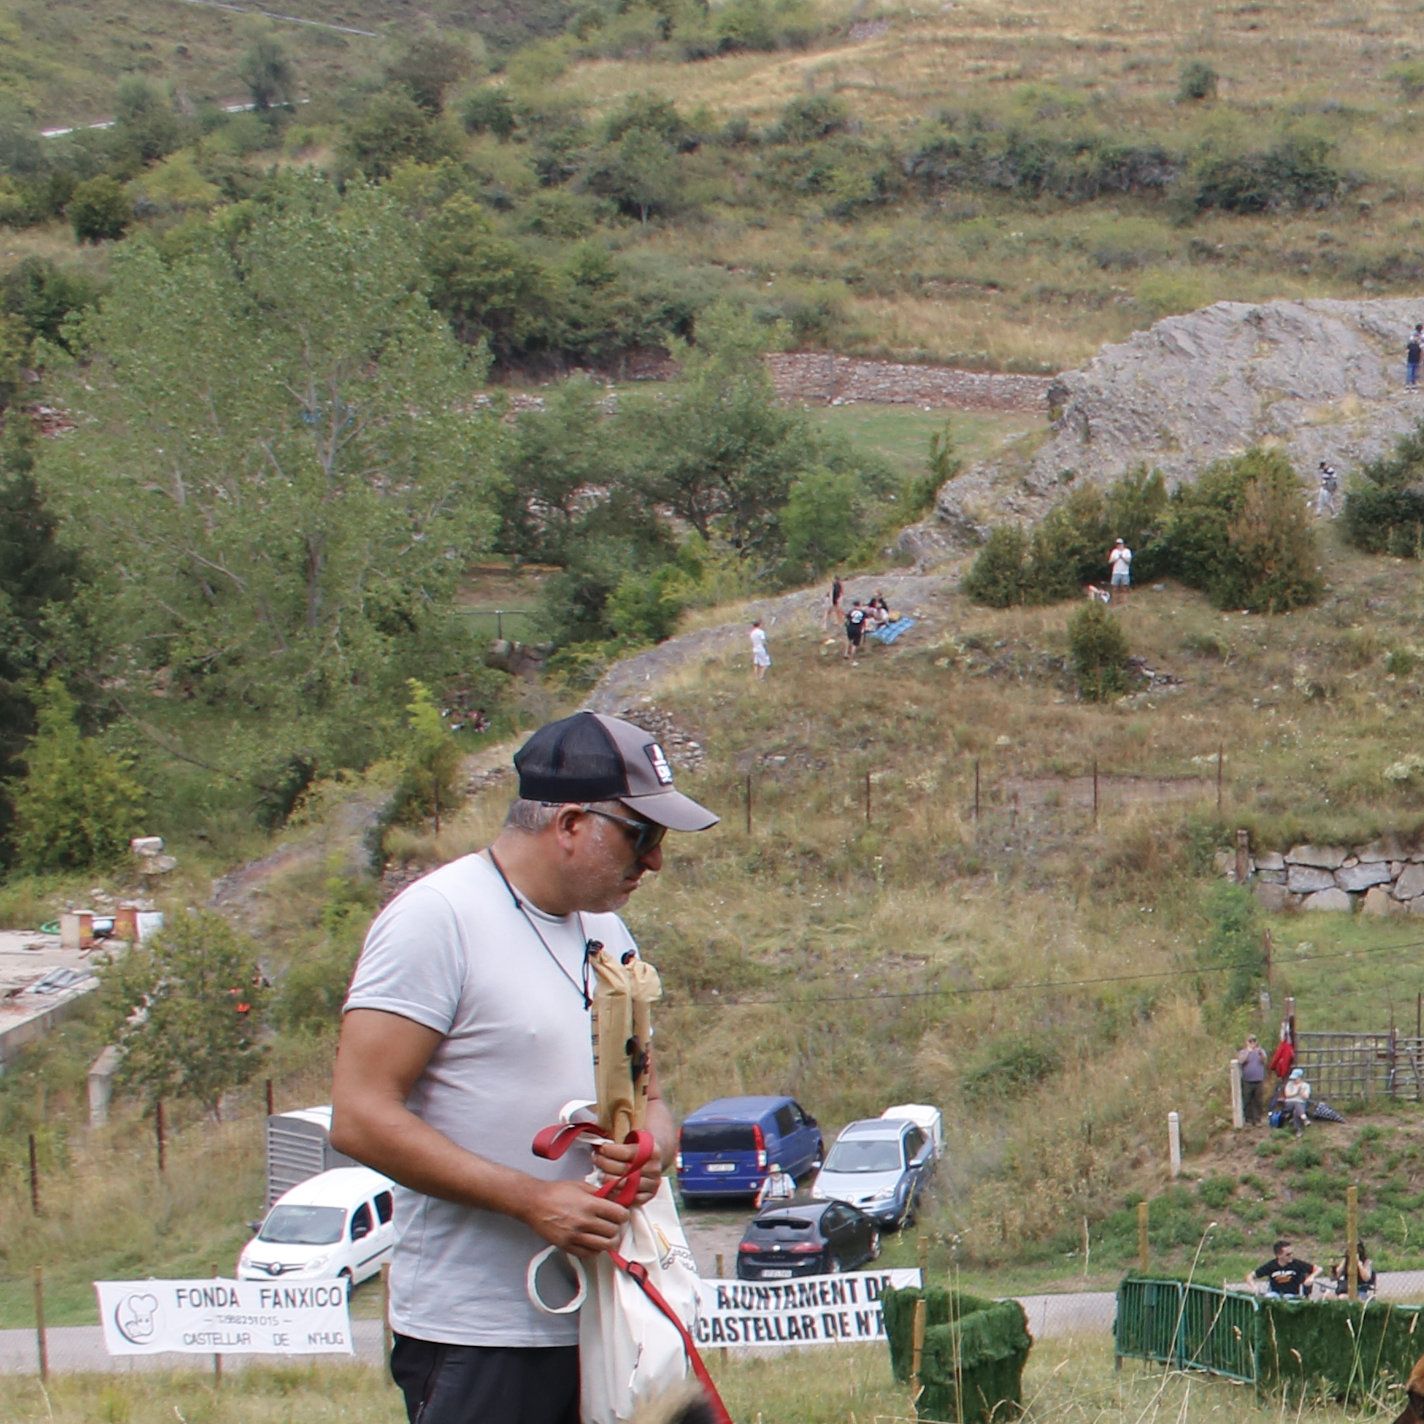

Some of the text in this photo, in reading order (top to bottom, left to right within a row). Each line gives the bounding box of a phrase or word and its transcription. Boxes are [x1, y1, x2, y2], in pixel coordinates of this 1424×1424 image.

[176, 1287, 343, 1308] FONDA FANXICO
[717, 1278, 858, 1310] AJUNTAMENT
[183, 1332, 252, 1346] CASTELLAR
[273, 1332, 290, 1346] DE
[696, 1313, 818, 1343] CASTELLAR
[822, 1310, 850, 1338] DE
